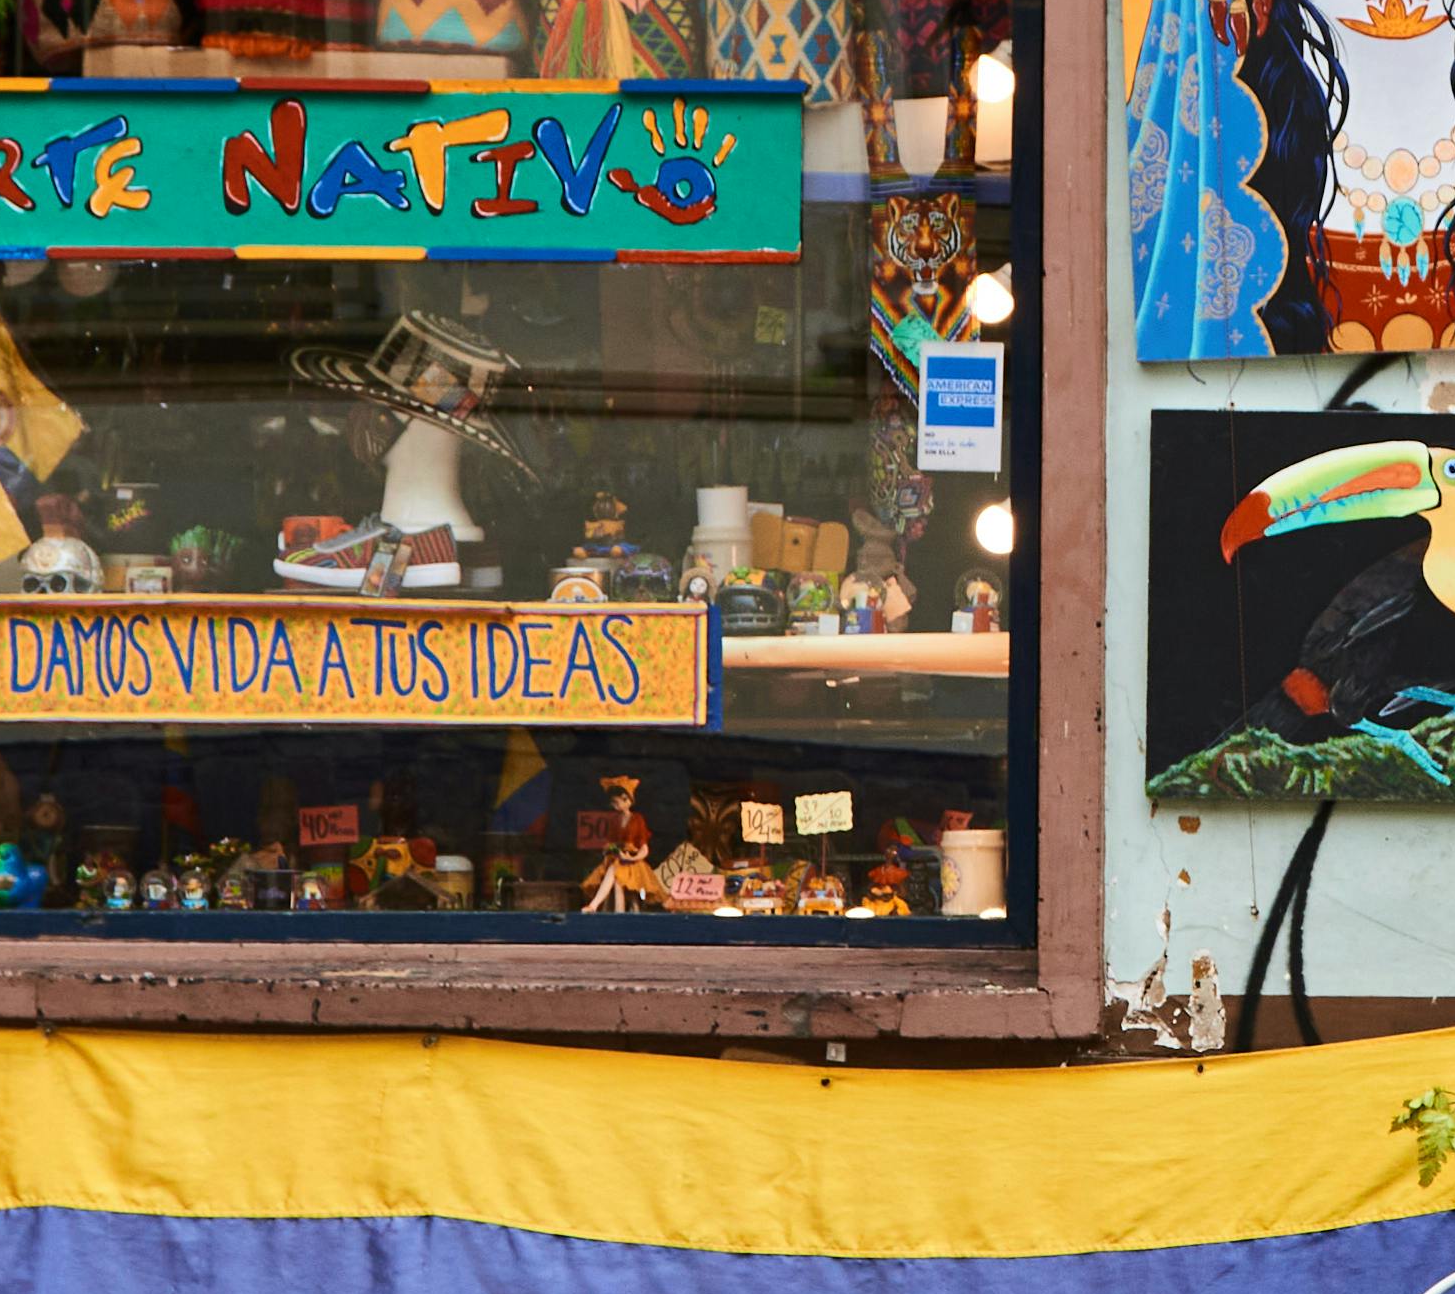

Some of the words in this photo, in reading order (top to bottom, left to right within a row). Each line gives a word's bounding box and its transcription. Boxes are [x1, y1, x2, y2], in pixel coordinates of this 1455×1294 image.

[222, 98, 720, 225] NATIVO
[927, 379, 991, 392] AMERICAN
[938, 394, 996, 406] EXPRESS
[9, 614, 153, 698] DAMOS
[160, 615, 303, 694] VIDA
[318, 619, 355, 699] A
[350, 618, 450, 703] TUS
[469, 614, 641, 706] IDEAS
[302, 812, 330, 842] 40
